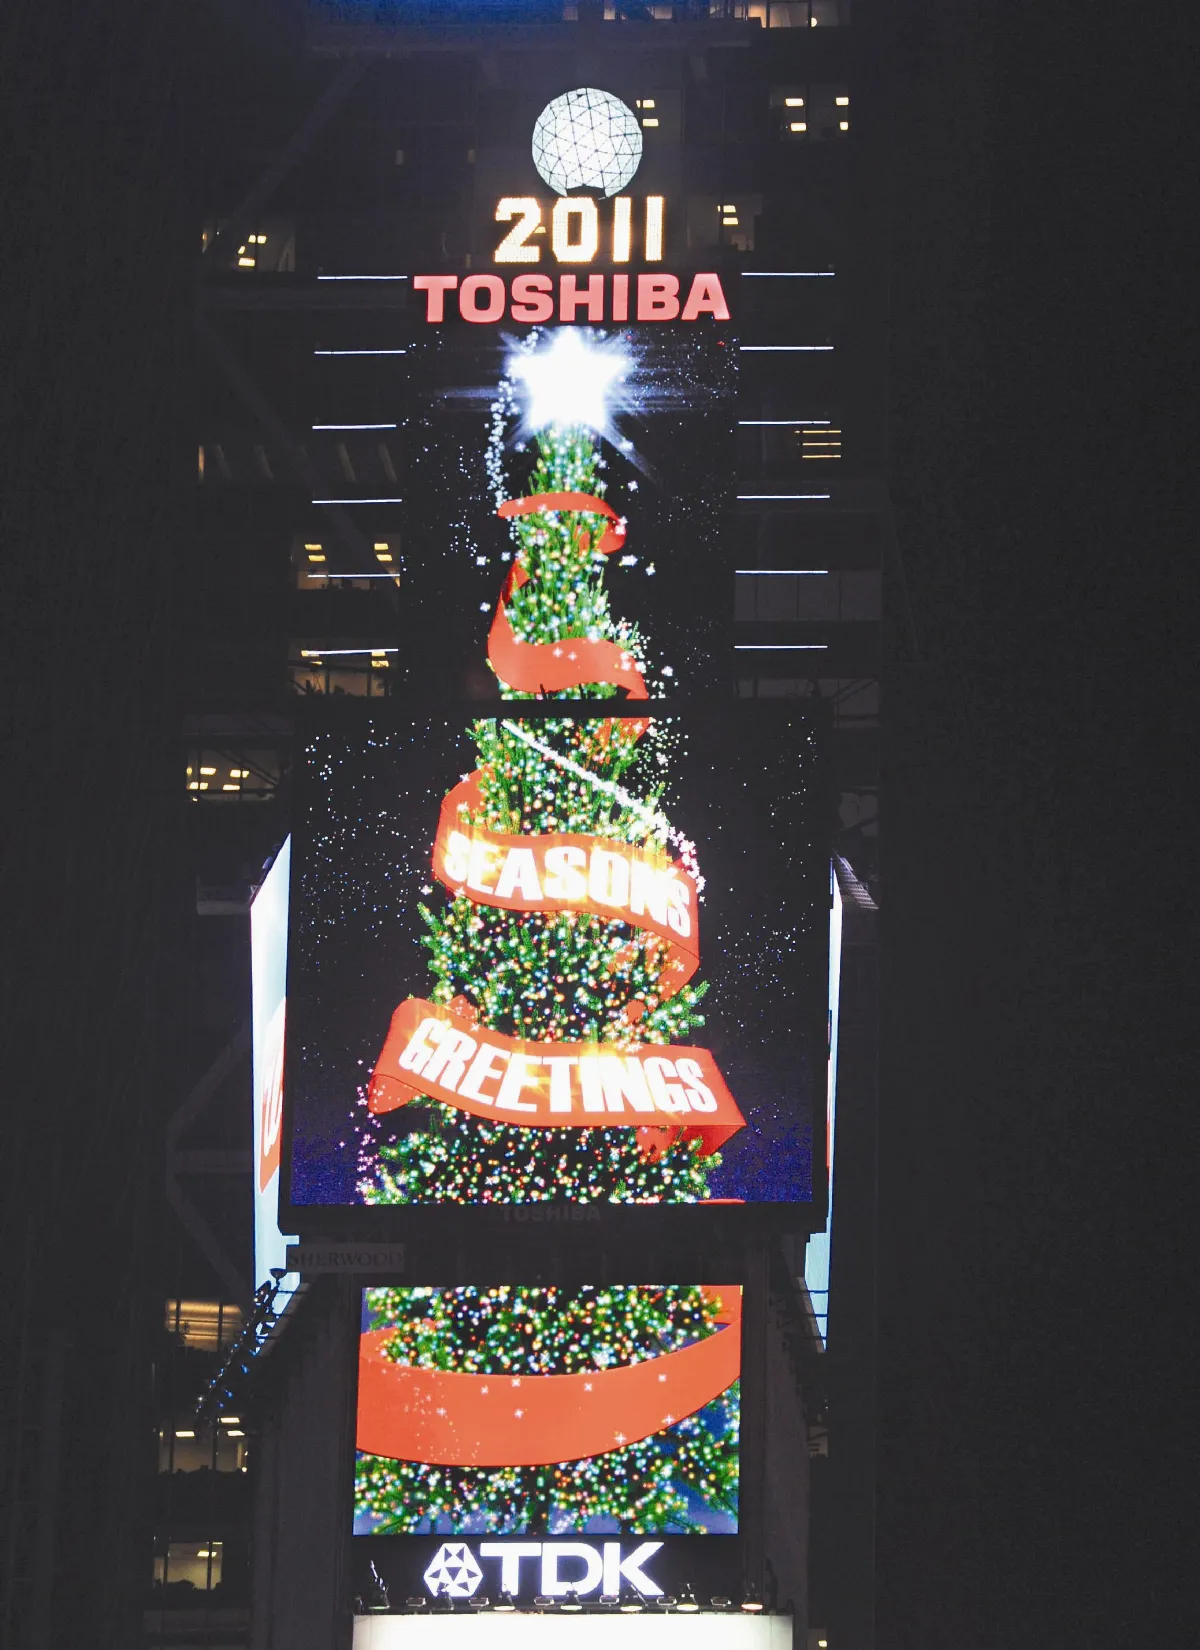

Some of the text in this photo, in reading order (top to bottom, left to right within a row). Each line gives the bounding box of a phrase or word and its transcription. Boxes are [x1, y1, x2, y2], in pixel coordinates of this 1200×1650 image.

[494, 196, 664, 263] 2011
[413, 272, 731, 323] TOSHIBA
[398, 1016, 719, 1113] GREETINGS
[499, 1204, 602, 1222] TOSHIBA
[288, 1250, 402, 1267] SHERWOOD
[479, 1541, 665, 1597] TDK
